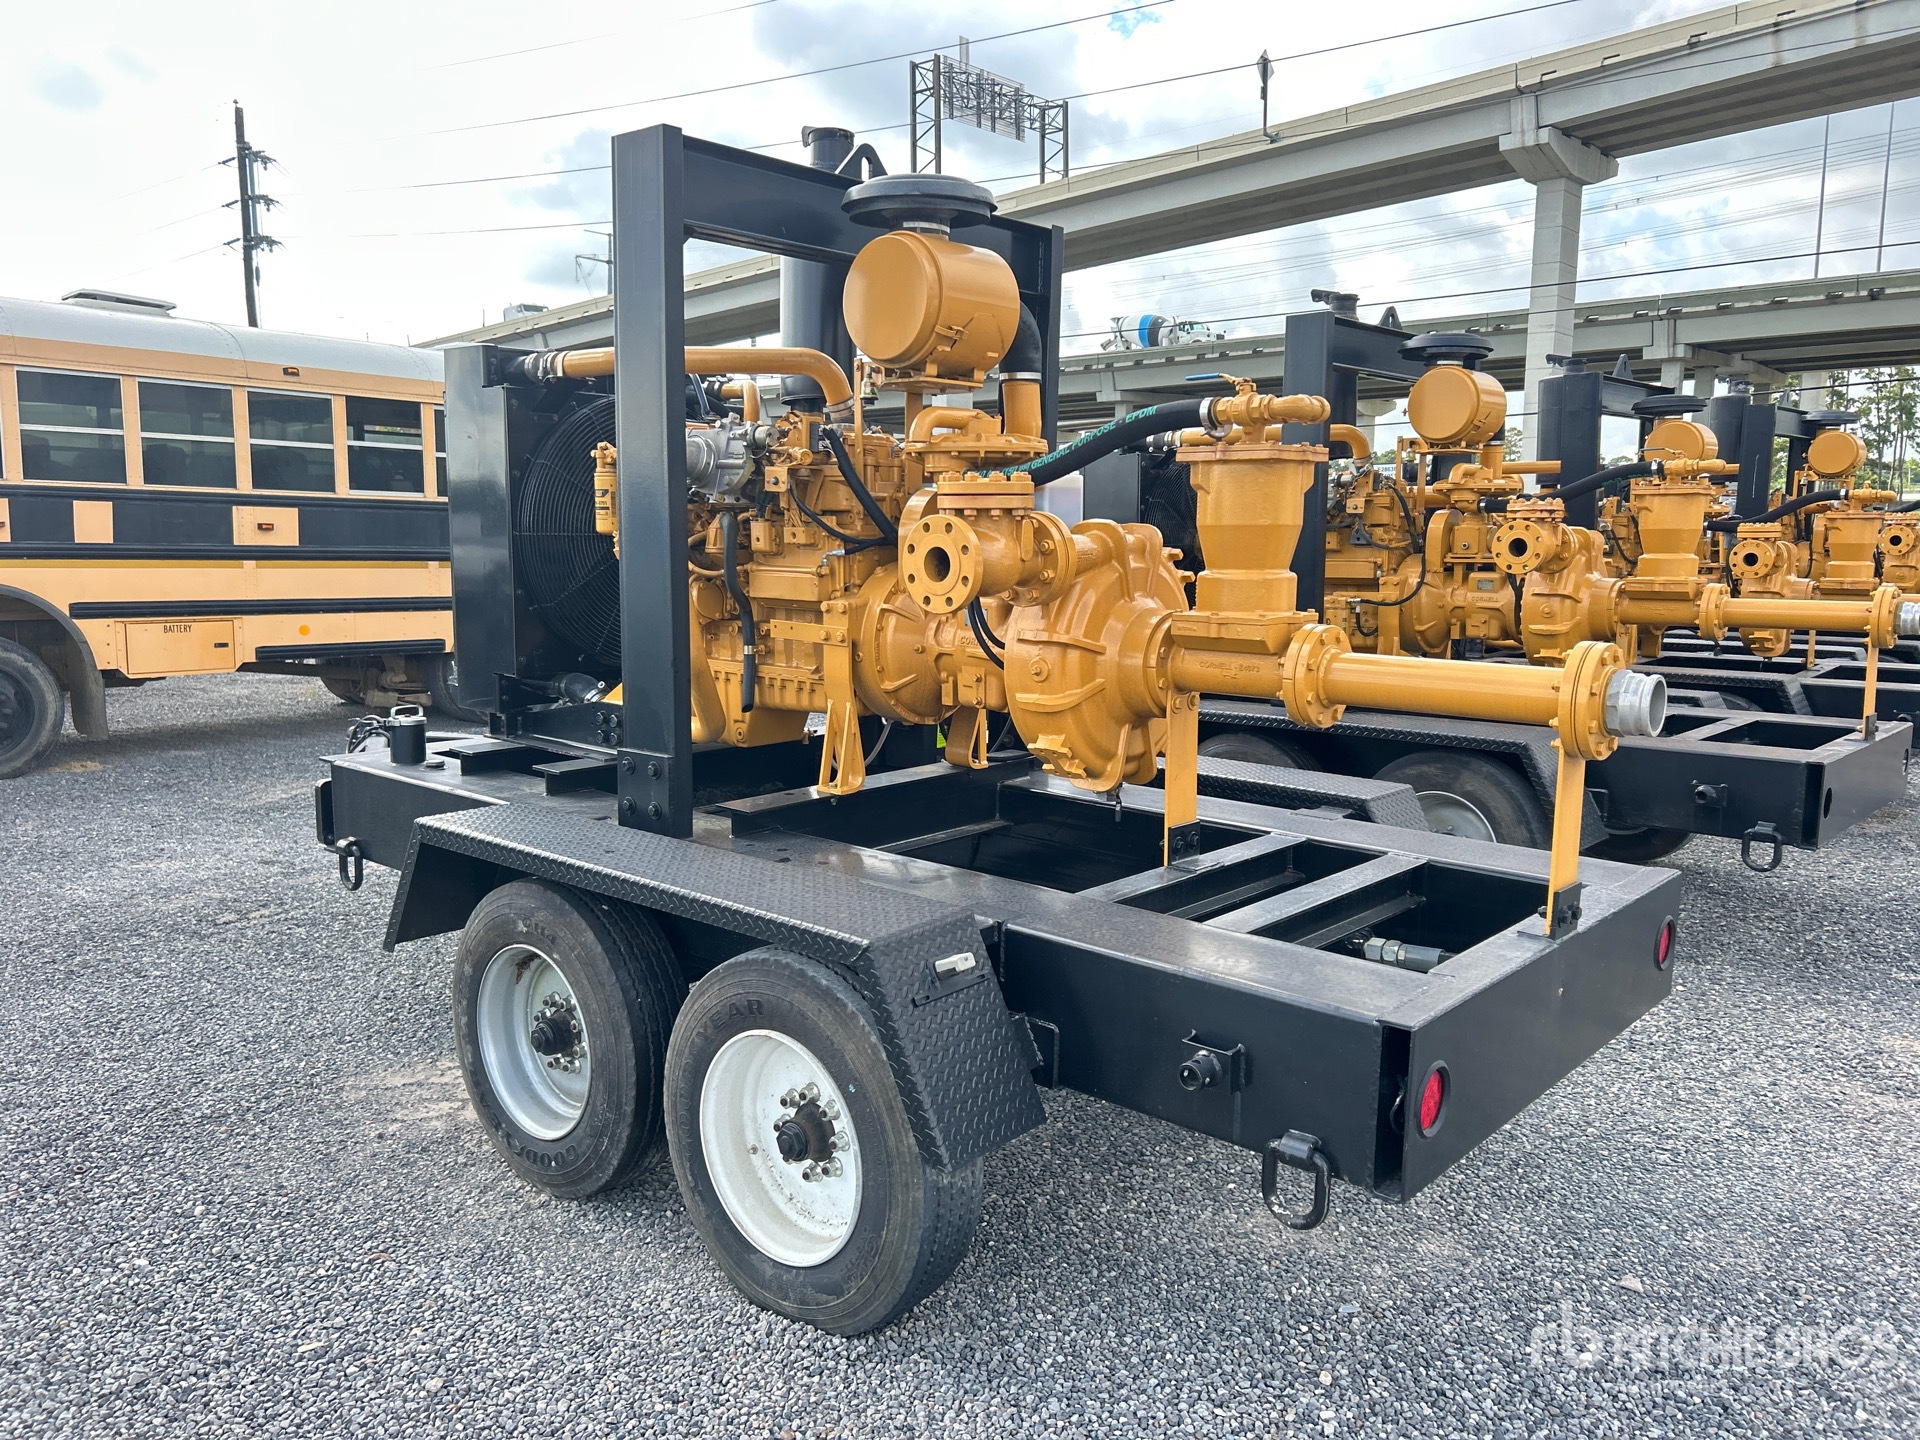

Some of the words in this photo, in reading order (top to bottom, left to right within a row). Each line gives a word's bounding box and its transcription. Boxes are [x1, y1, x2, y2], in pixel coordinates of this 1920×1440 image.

[1031, 447, 1070, 469] GENERAL
[1071, 419, 1118, 450] PURPOSE
[1125, 405, 1158, 423] EPDM
[163, 624, 192, 634] BATTERY
